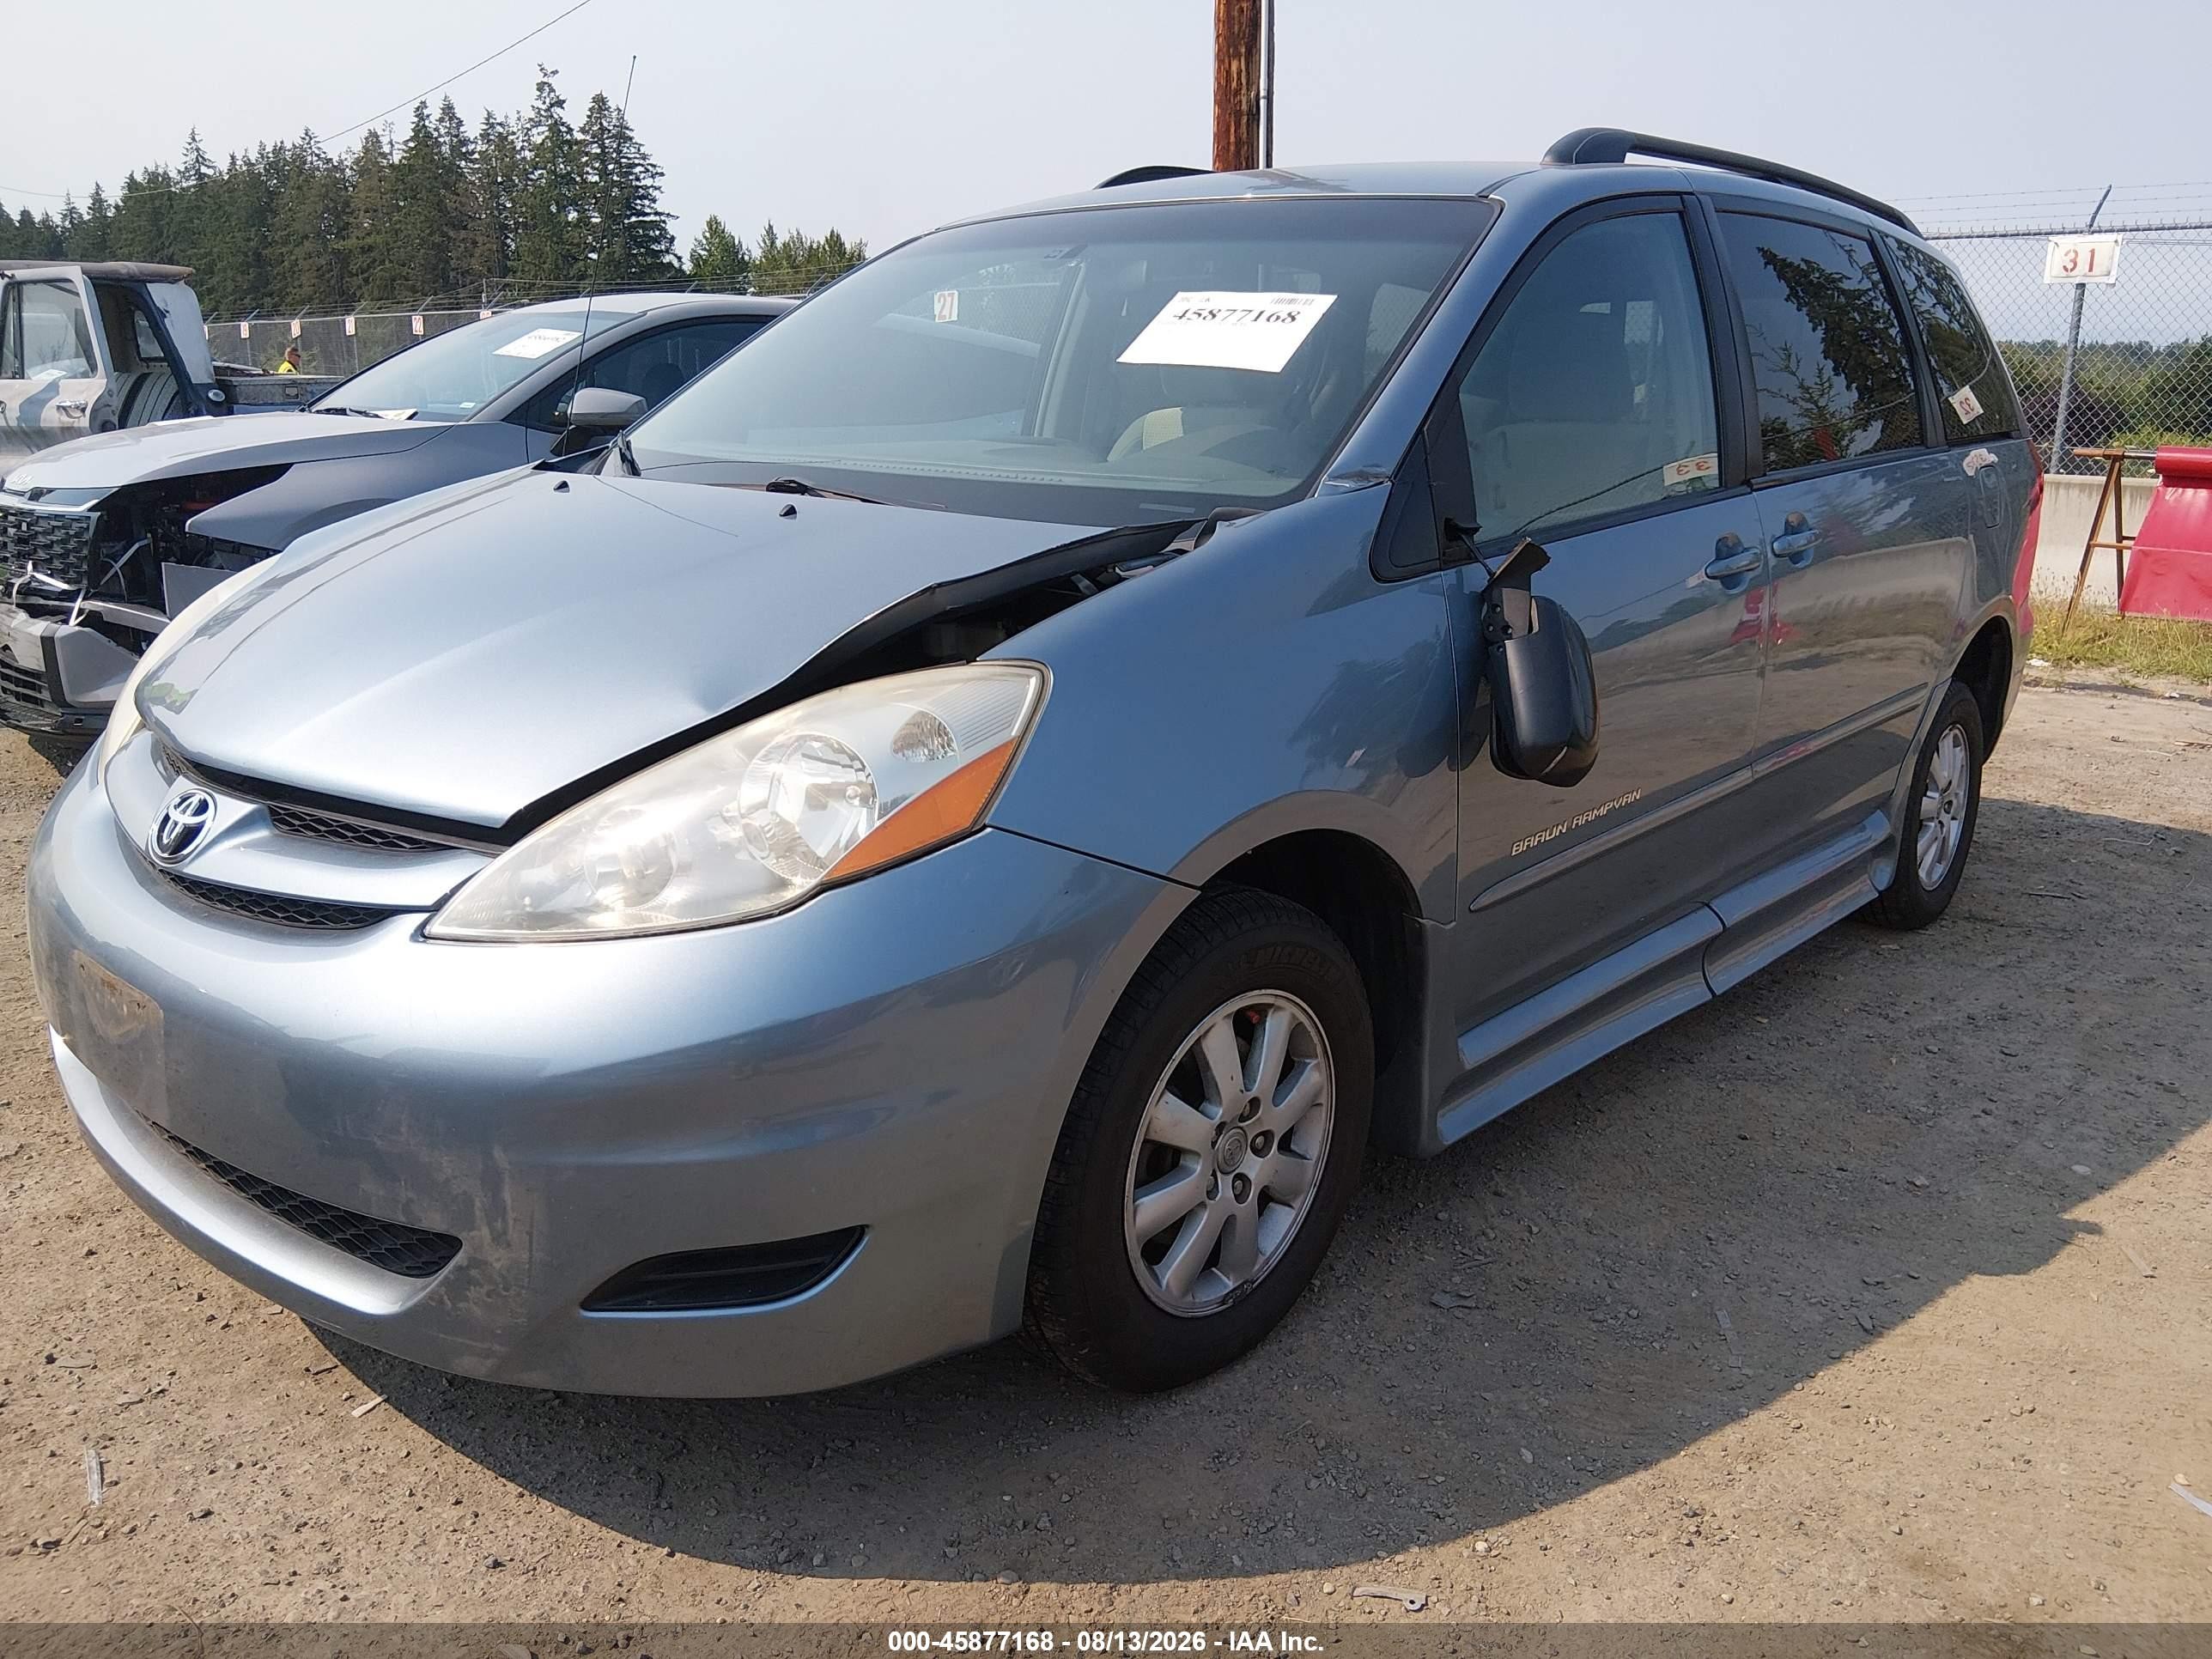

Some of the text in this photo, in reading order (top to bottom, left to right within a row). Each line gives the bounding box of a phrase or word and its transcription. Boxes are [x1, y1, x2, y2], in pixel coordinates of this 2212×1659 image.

[2063, 247, 2096, 273] 31
[413, 317, 422, 333] 22
[1172, 307, 1302, 325] 45877168
[1510, 788, 1642, 857] BRAUN RAMPVAN
